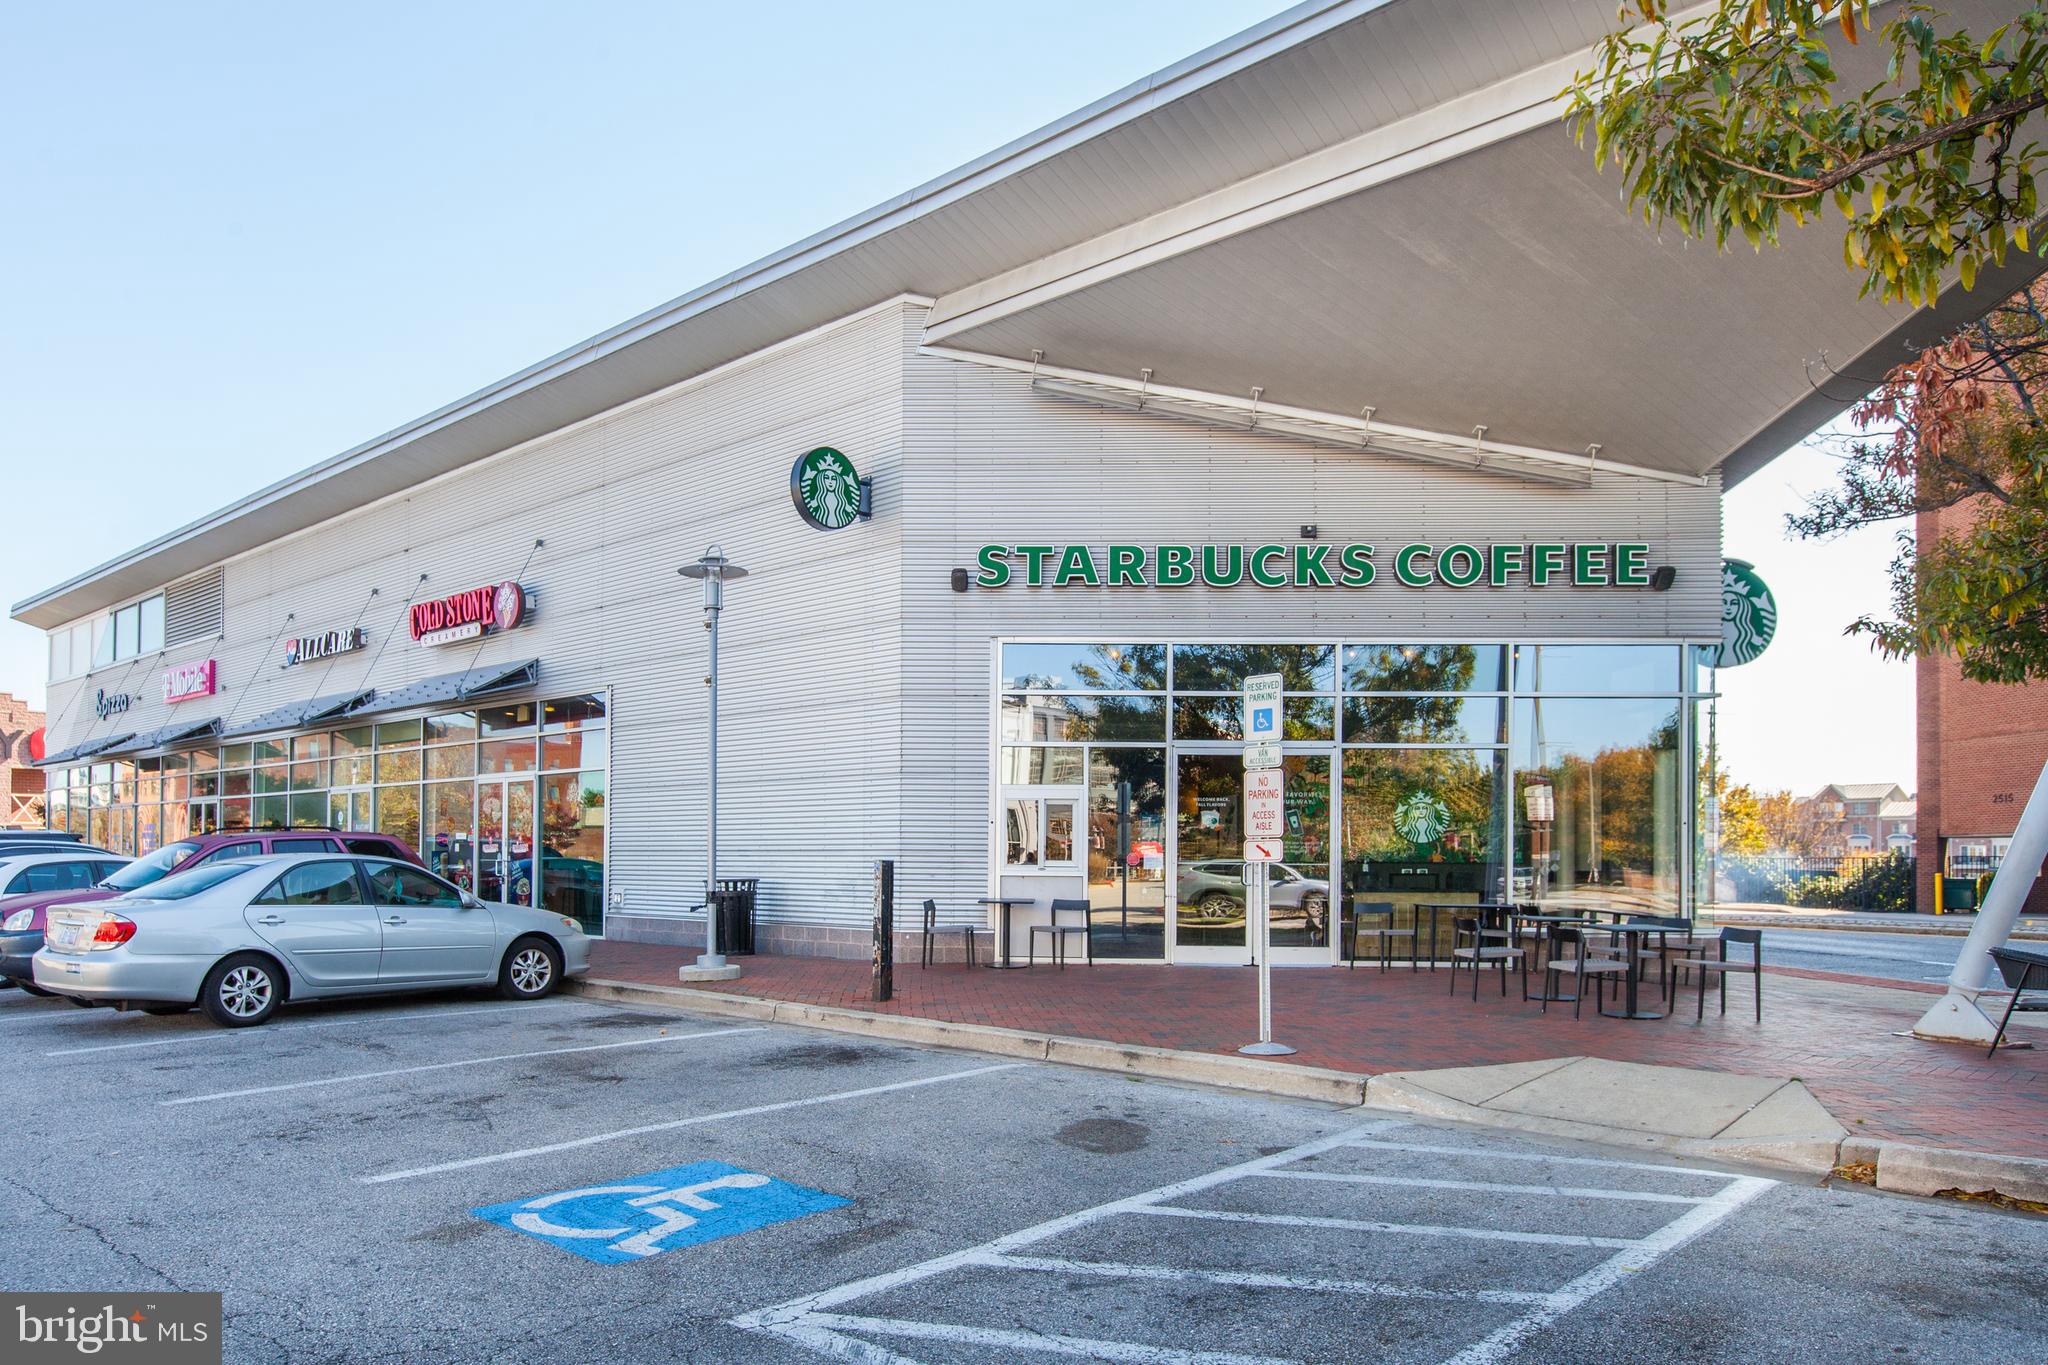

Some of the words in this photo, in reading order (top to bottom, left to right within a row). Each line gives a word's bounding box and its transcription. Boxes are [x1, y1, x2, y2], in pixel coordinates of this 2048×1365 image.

[975, 543, 1376, 588] STARBUCKS
[1394, 543, 1651, 588] COFFEE
[409, 601, 445, 641] COLD
[446, 585, 495, 628] STONE
[423, 625, 480, 646] CREAMERY
[1247, 680, 1279, 692] RESERVED
[1249, 691, 1277, 702] PARKING
[1257, 748, 1269, 757] VAN
[1258, 777, 1268, 787] NO
[1248, 790, 1279, 800] PARKING
[1992, 793, 2014, 804] 2515
[1252, 810, 1276, 820] ACCESS
[1255, 821, 1273, 831] AISLE
